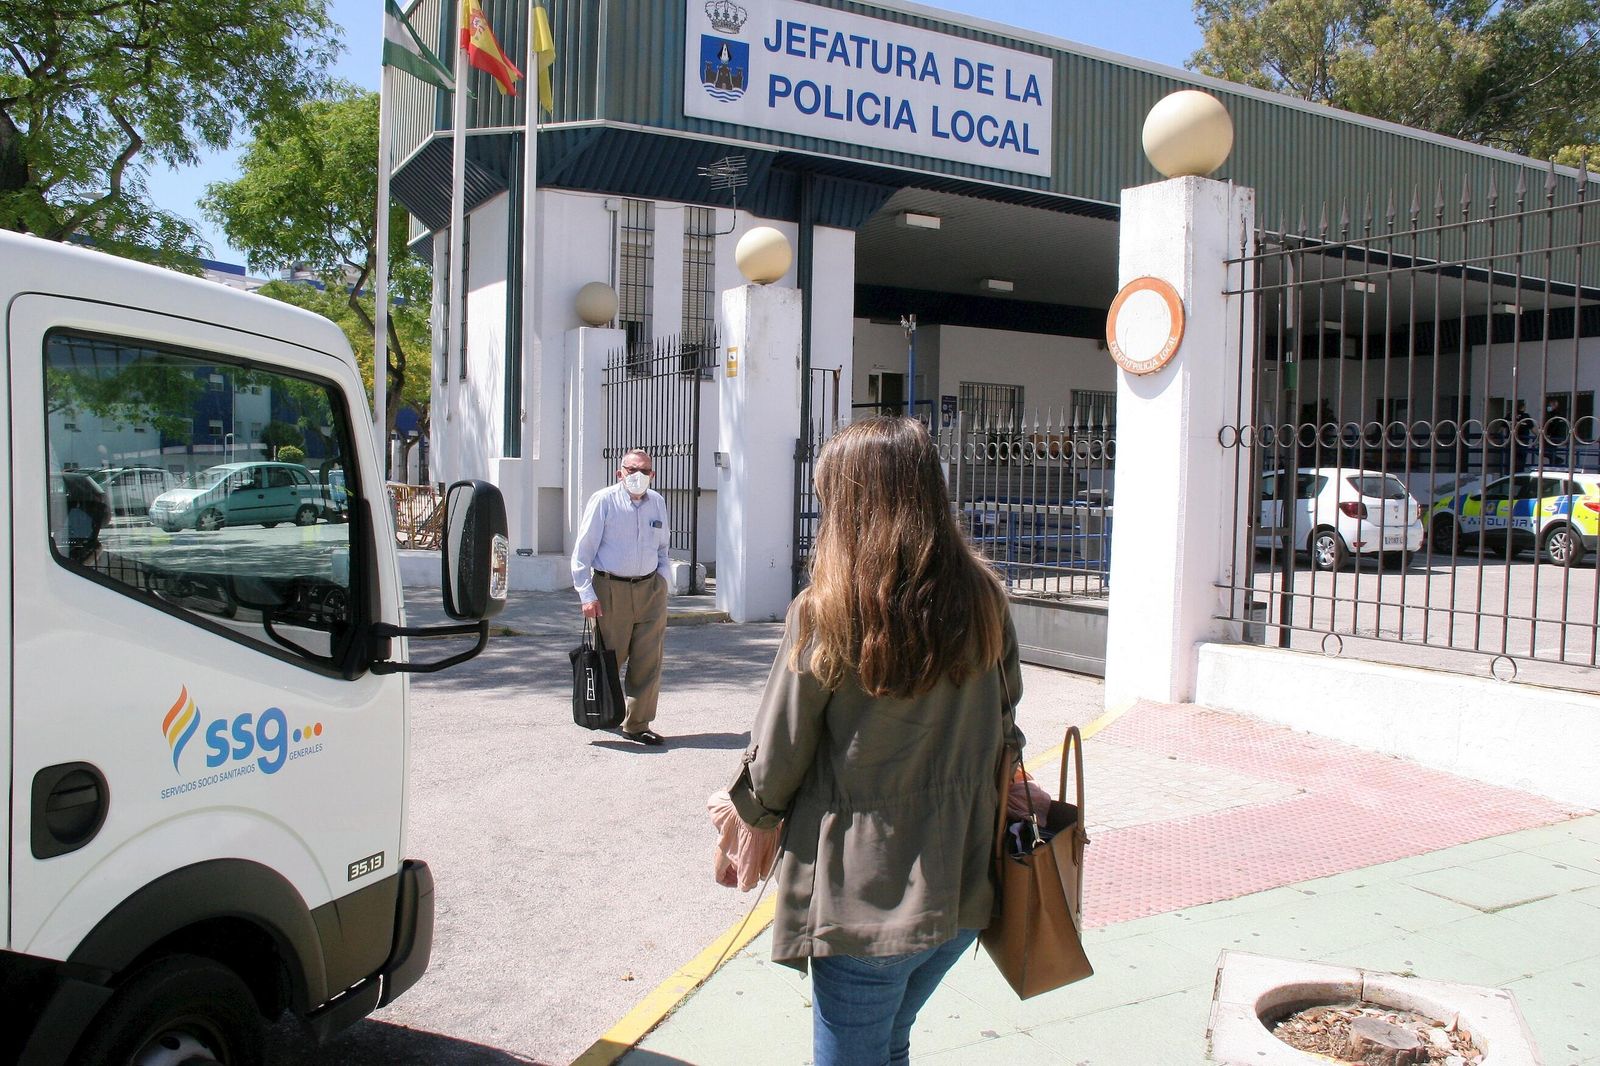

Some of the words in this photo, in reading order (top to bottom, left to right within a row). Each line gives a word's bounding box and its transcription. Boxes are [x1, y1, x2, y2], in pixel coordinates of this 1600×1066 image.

[764, 19, 941, 85] JEFATURA
[954, 57, 994, 96] DE
[1005, 69, 1043, 107] LA
[768, 73, 917, 134] POLICIA
[931, 105, 1040, 156] LOCAL
[1110, 340, 1132, 369] EXCEPTO
[1132, 358, 1158, 371] POLICIA
[1159, 335, 1177, 361] LOCAL
[160, 780, 197, 800] SERVICIOS
[197, 774, 219, 788] SOCIO
[219, 763, 256, 783] SANITARIOS
[288, 743, 323, 761] GENERALES
[350, 855, 383, 879] 35.13
